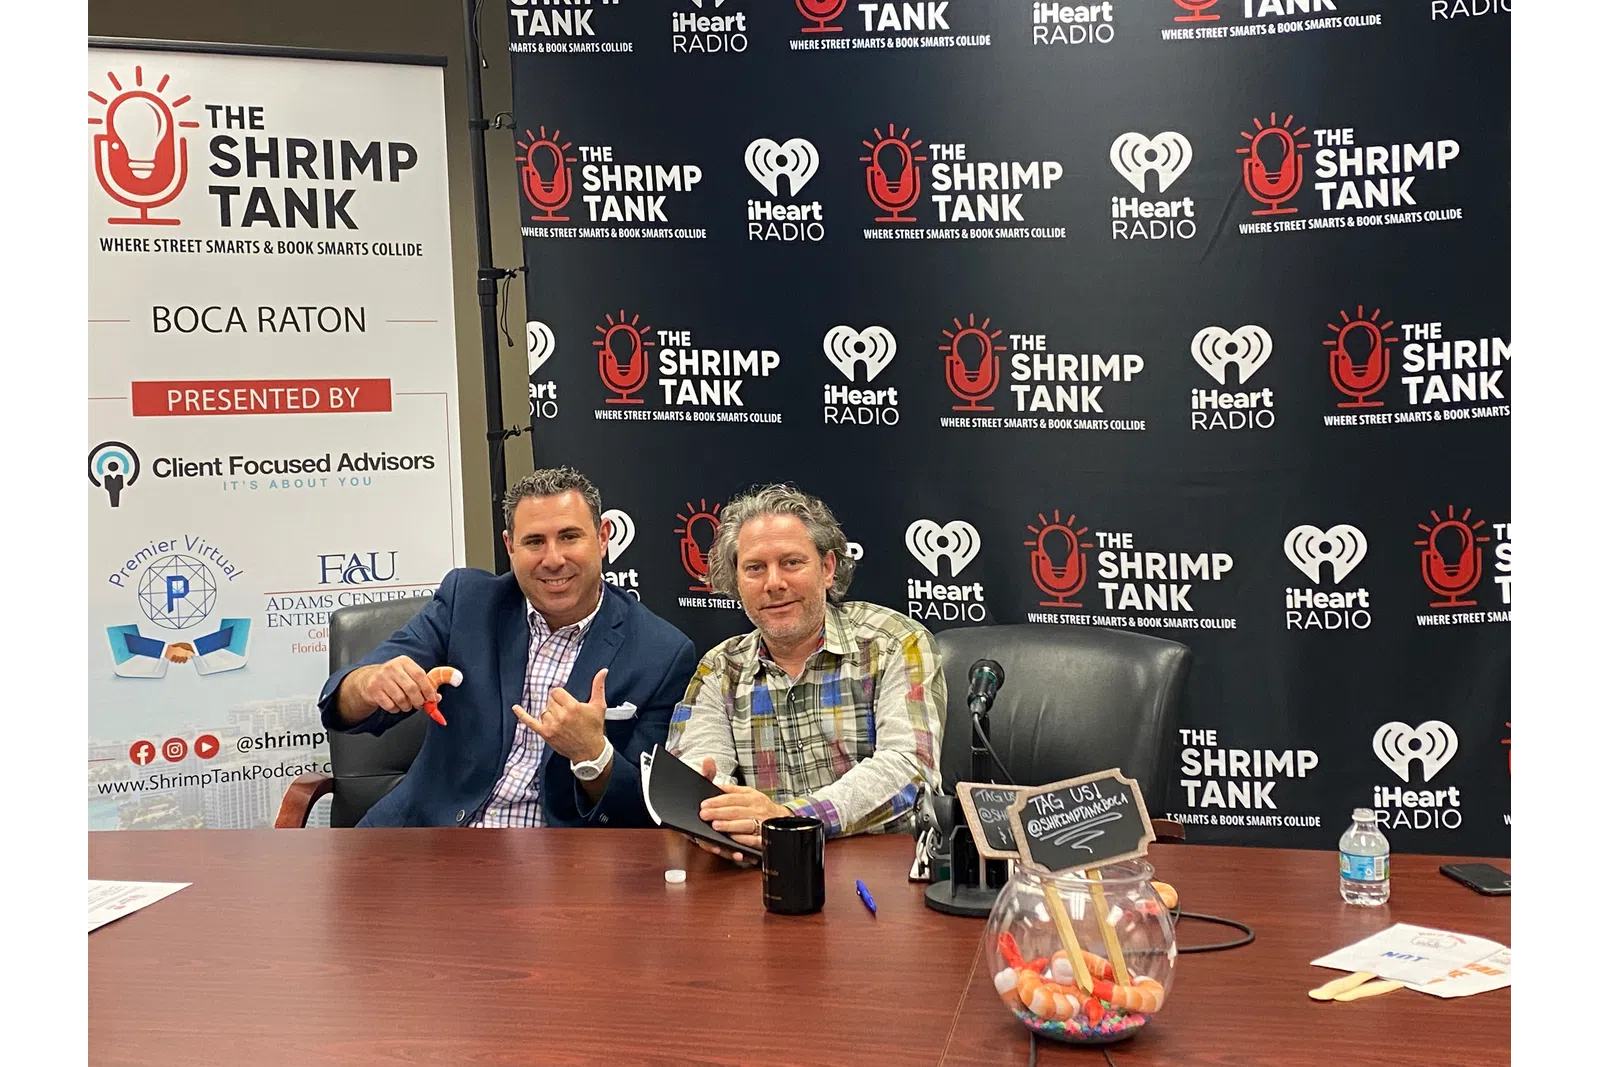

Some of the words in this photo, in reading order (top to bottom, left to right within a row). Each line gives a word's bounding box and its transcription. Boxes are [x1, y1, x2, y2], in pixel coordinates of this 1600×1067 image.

[511, 9, 595, 35] TANK
[673, 12, 746, 32] iHeart
[859, 2, 950, 31] TANK
[1034, 2, 1112, 23] iHeart
[1034, 24, 1114, 45] RADIO
[1161, 28, 1195, 40] WHERE
[1195, 27, 1229, 39] STREET
[1229, 24, 1267, 37] SMARTS
[1268, 24, 1276, 34] &
[1277, 21, 1303, 33] BOOK
[1304, 17, 1342, 30] SMARTS
[1343, 14, 1381, 27] COLLIDE
[673, 34, 747, 52] RADIO
[790, 40, 820, 50] WHERE
[821, 39, 851, 49] STREET
[852, 38, 886, 48] SMARTS
[887, 38, 894, 48] &
[895, 37, 919, 48] BOOK
[920, 36, 955, 47] SMARTS
[955, 35, 991, 46] COLLIDE
[205, 105, 264, 130] THE
[1314, 128, 1354, 146] THE
[209, 135, 417, 182] SHRIMP
[579, 147, 612, 162] THE
[929, 144, 966, 160] THE
[1315, 140, 1459, 178] SHRIMP
[583, 165, 702, 191] SHRIMP
[932, 162, 1063, 191] SHRIMP
[1315, 176, 1416, 210] TANK
[209, 186, 358, 229] TANK
[583, 195, 668, 221] TANK
[748, 200, 822, 220] iHeart
[932, 194, 1024, 222] TANK
[1112, 196, 1194, 218] iHeart
[1113, 220, 1196, 239] RADIO
[1239, 222, 1272, 234] WHERE
[1273, 220, 1307, 232] STREET
[1308, 217, 1346, 229] SMARTS
[1347, 217, 1355, 227] &
[1356, 215, 1383, 226] BOOK
[1384, 212, 1422, 224] SMARTS
[1423, 208, 1462, 221] COLLIDE
[520, 227, 549, 237] WHERE
[550, 228, 577, 238] STREET
[578, 228, 610, 238] SMARTS
[611, 228, 617, 238] &
[618, 228, 641, 238] BOOK
[641, 228, 673, 238] SMARTS
[674, 229, 706, 238] COLLIDE
[749, 223, 824, 241] RADIO
[864, 229, 894, 239] WHERE
[895, 229, 925, 239] STREET
[926, 229, 960, 239] SMARTS
[961, 229, 968, 239] &
[970, 228, 994, 239] BOOK
[995, 228, 1030, 238] SMARTS
[1031, 228, 1066, 238] COLLIDE
[100, 238, 150, 252] WHERE
[154, 239, 202, 253] STREET
[206, 240, 260, 254] SMARTS
[263, 241, 273, 254] &
[277, 241, 314, 254] BOOK
[317, 242, 369, 255] SMARTS
[372, 243, 423, 256] COLLIDE
[153, 306, 247, 333] BOCA
[258, 307, 365, 332] RATON
[657, 331, 691, 346] THE
[1402, 322, 1441, 341] THE
[1010, 335, 1046, 350] THE
[659, 349, 780, 376] SHRIMP
[1011, 353, 1144, 381] SHRIMP
[659, 379, 743, 406] TANK
[825, 384, 897, 405] iHeart
[1402, 370, 1504, 404] TANK
[168, 388, 319, 411] PRESENTED
[330, 388, 359, 408] BY
[1011, 385, 1103, 412] TANK
[1192, 388, 1273, 409] iHeart
[595, 410, 623, 420] WHERE
[624, 410, 651, 420] STREET
[653, 411, 684, 421] SMARTS
[685, 411, 692, 421] &
[693, 412, 715, 421] BOOK
[716, 412, 748, 422] SMARTS
[749, 413, 782, 423] COLLIDE
[825, 406, 899, 425] RADIO
[940, 418, 971, 427] WHERE
[972, 418, 1002, 428] STREET
[1004, 418, 1038, 428] SMARTS
[1039, 419, 1047, 428] &
[1048, 419, 1072, 429] BOOK
[1073, 420, 1109, 430] SMARTS
[1110, 420, 1146, 430] COLLIDE
[1192, 410, 1274, 430] RADIO
[1324, 415, 1358, 426] WHERE
[1359, 413, 1393, 425] STREET
[1394, 411, 1432, 423] SMARTS
[1434, 410, 1442, 421] &
[1443, 409, 1470, 420] BOOK
[1471, 405, 1510, 418] SMARTS
[153, 458, 223, 478] Client
[230, 454, 330, 475] Focused
[337, 452, 434, 472] Advisors
[224, 481, 258, 490] IT'S
[269, 478, 327, 488] ABOUT
[338, 477, 371, 486] YOU
[1096, 532, 1133, 548] THE
[108, 538, 177, 588] Premier
[186, 534, 244, 582] Virtual
[318, 551, 397, 584] FAU
[1098, 551, 1233, 580] SHRIMP
[908, 579, 984, 601] iHeart
[1098, 582, 1193, 611] TANK
[1286, 588, 1369, 608] iHeart
[266, 595, 333, 611] ADAMS
[678, 597, 707, 607] WHERE
[708, 599, 735, 609] STREET
[908, 602, 985, 622] RADIO
[1028, 613, 1059, 623] WHERE
[1060, 614, 1091, 625] STREET
[1092, 616, 1127, 626] SMARTS
[1128, 617, 1136, 627] &
[1137, 617, 1162, 627] BOOK
[1163, 618, 1199, 628] SMARTS
[1200, 618, 1236, 629] COLLIDE
[1287, 610, 1371, 629] RADIO
[1417, 614, 1451, 625] WHERE
[1452, 612, 1485, 624] STREET
[292, 642, 326, 653] Florida
[1179, 729, 1217, 746] THE
[1181, 748, 1318, 777] SHRIMP
[974, 790, 1003, 803] TAG
[1028, 793, 1064, 815] TAG
[1181, 780, 1277, 809] TANK
[1374, 786, 1460, 807] iHeart
[1174, 813, 1209, 824] SMARTS
[1210, 815, 1219, 825] &
[1219, 815, 1245, 825] BOOK
[1246, 816, 1283, 826] SMARTS
[1283, 816, 1321, 827] COLLIDE
[1375, 809, 1461, 829] RADIO
